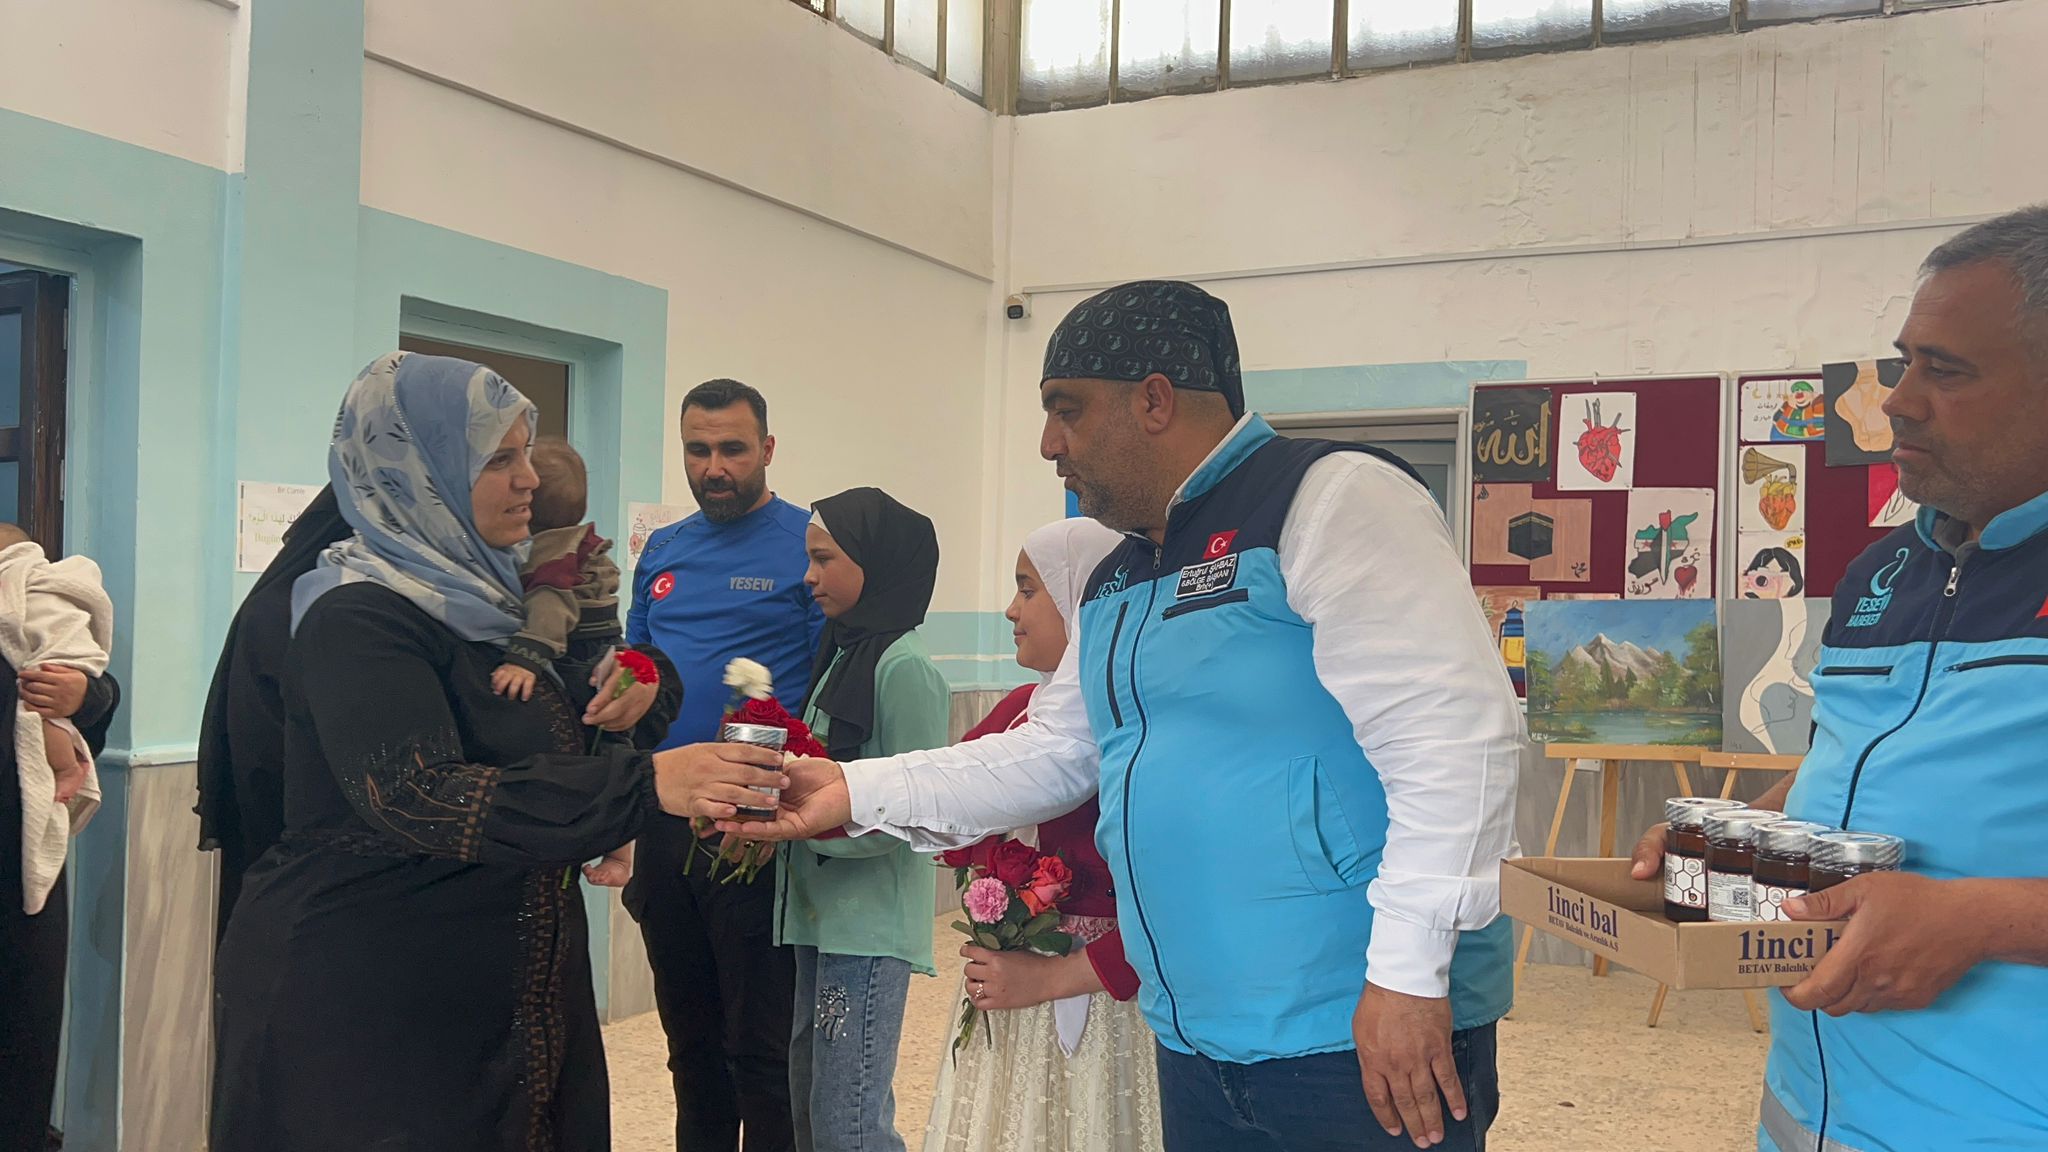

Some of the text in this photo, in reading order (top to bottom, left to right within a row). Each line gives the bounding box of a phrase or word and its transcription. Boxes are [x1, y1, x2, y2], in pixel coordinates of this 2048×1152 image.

[1547, 886, 1618, 938] 1inci bal
[1738, 928, 1815, 960] 1inci
[1738, 963, 1772, 974] BETAV
